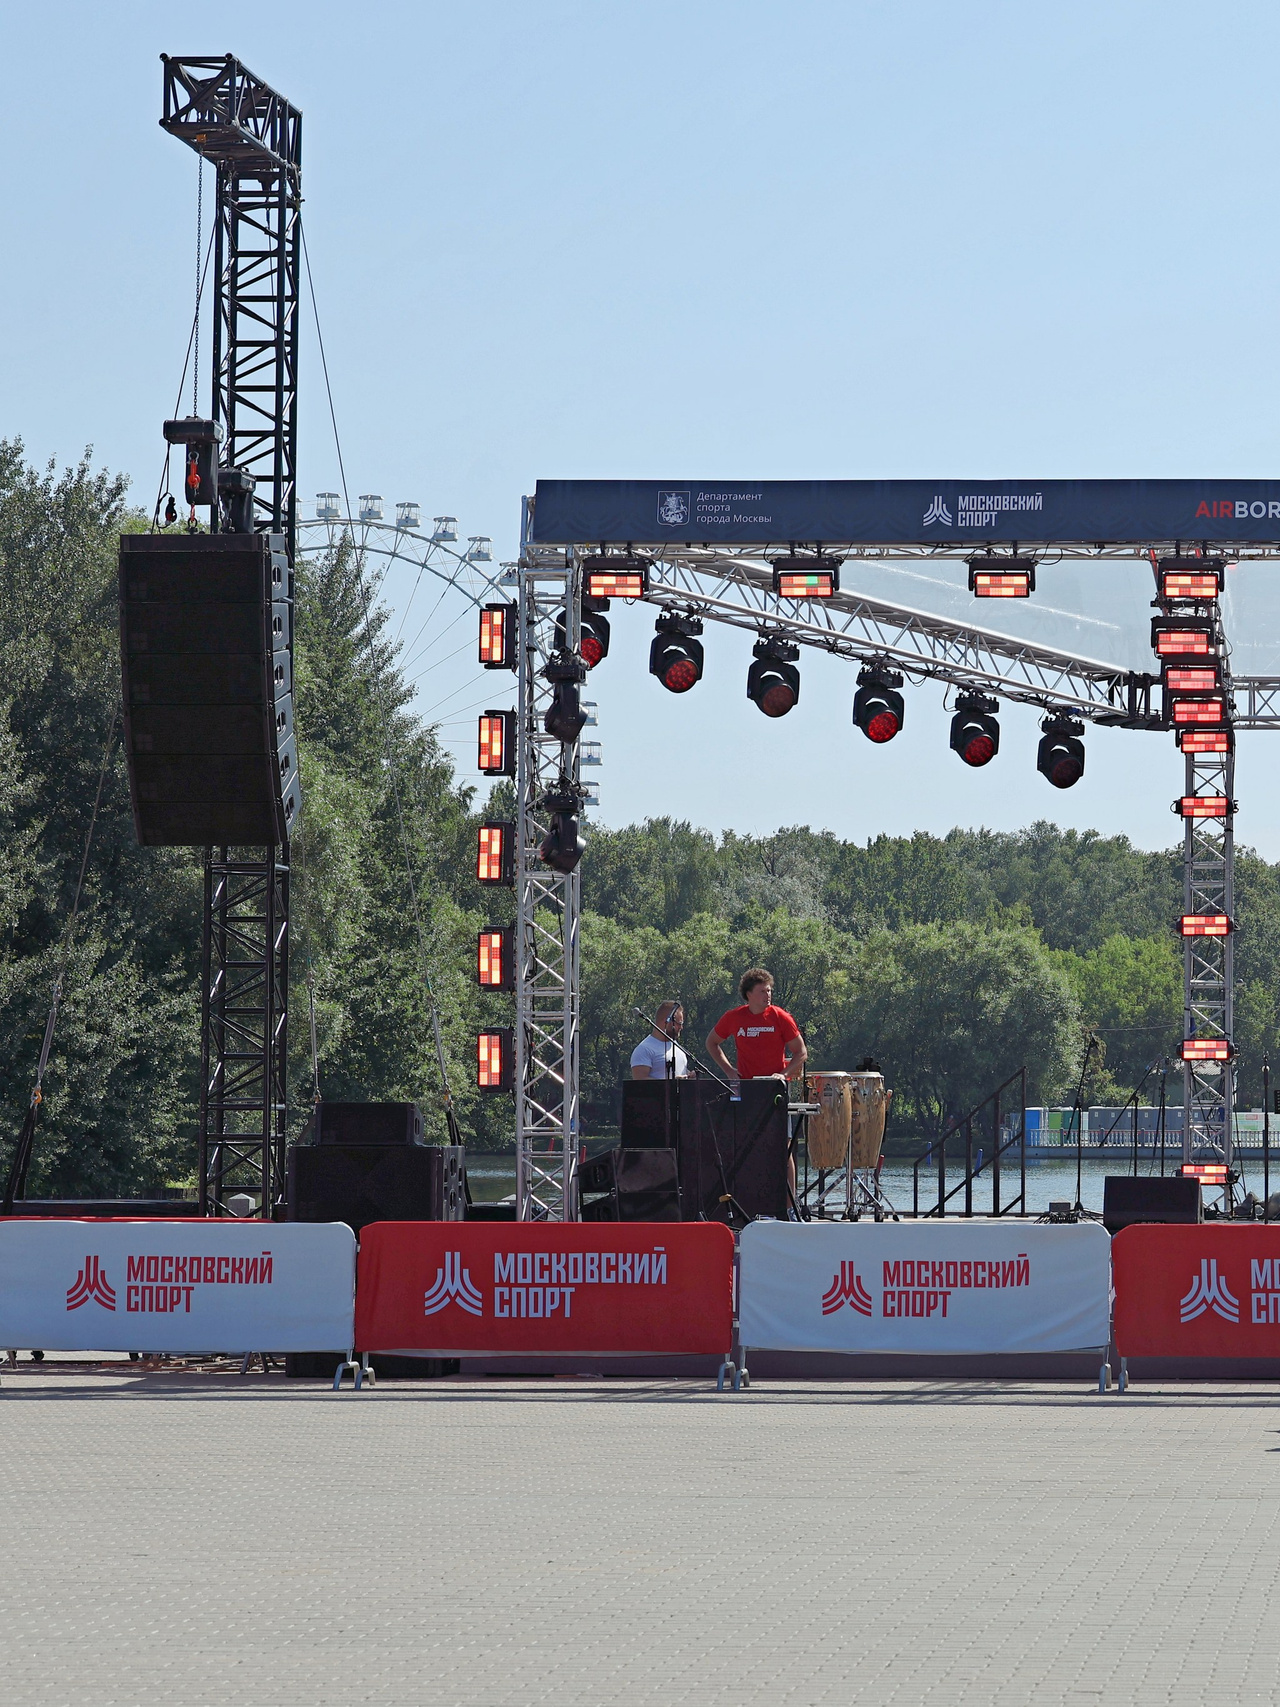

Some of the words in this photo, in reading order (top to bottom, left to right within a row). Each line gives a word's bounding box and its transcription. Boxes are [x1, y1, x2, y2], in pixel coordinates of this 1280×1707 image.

[696, 492, 763, 502] Департамент
[696, 504, 731, 513] спорта
[958, 493, 1043, 511] МОСКОВСКИЙ
[696, 515, 731, 525] города
[733, 514, 772, 523] Москвы
[957, 511, 998, 527] СПОРТ
[127, 1251, 273, 1284] МОСКОВСКИЙ
[494, 1246, 667, 1284] МОСКОВСКИЙ
[883, 1253, 1030, 1289] МОСКОВСКИЙ
[127, 1286, 194, 1313] СПОРТ
[494, 1287, 573, 1318] СПОРТ
[883, 1290, 951, 1318] СПОРТ
